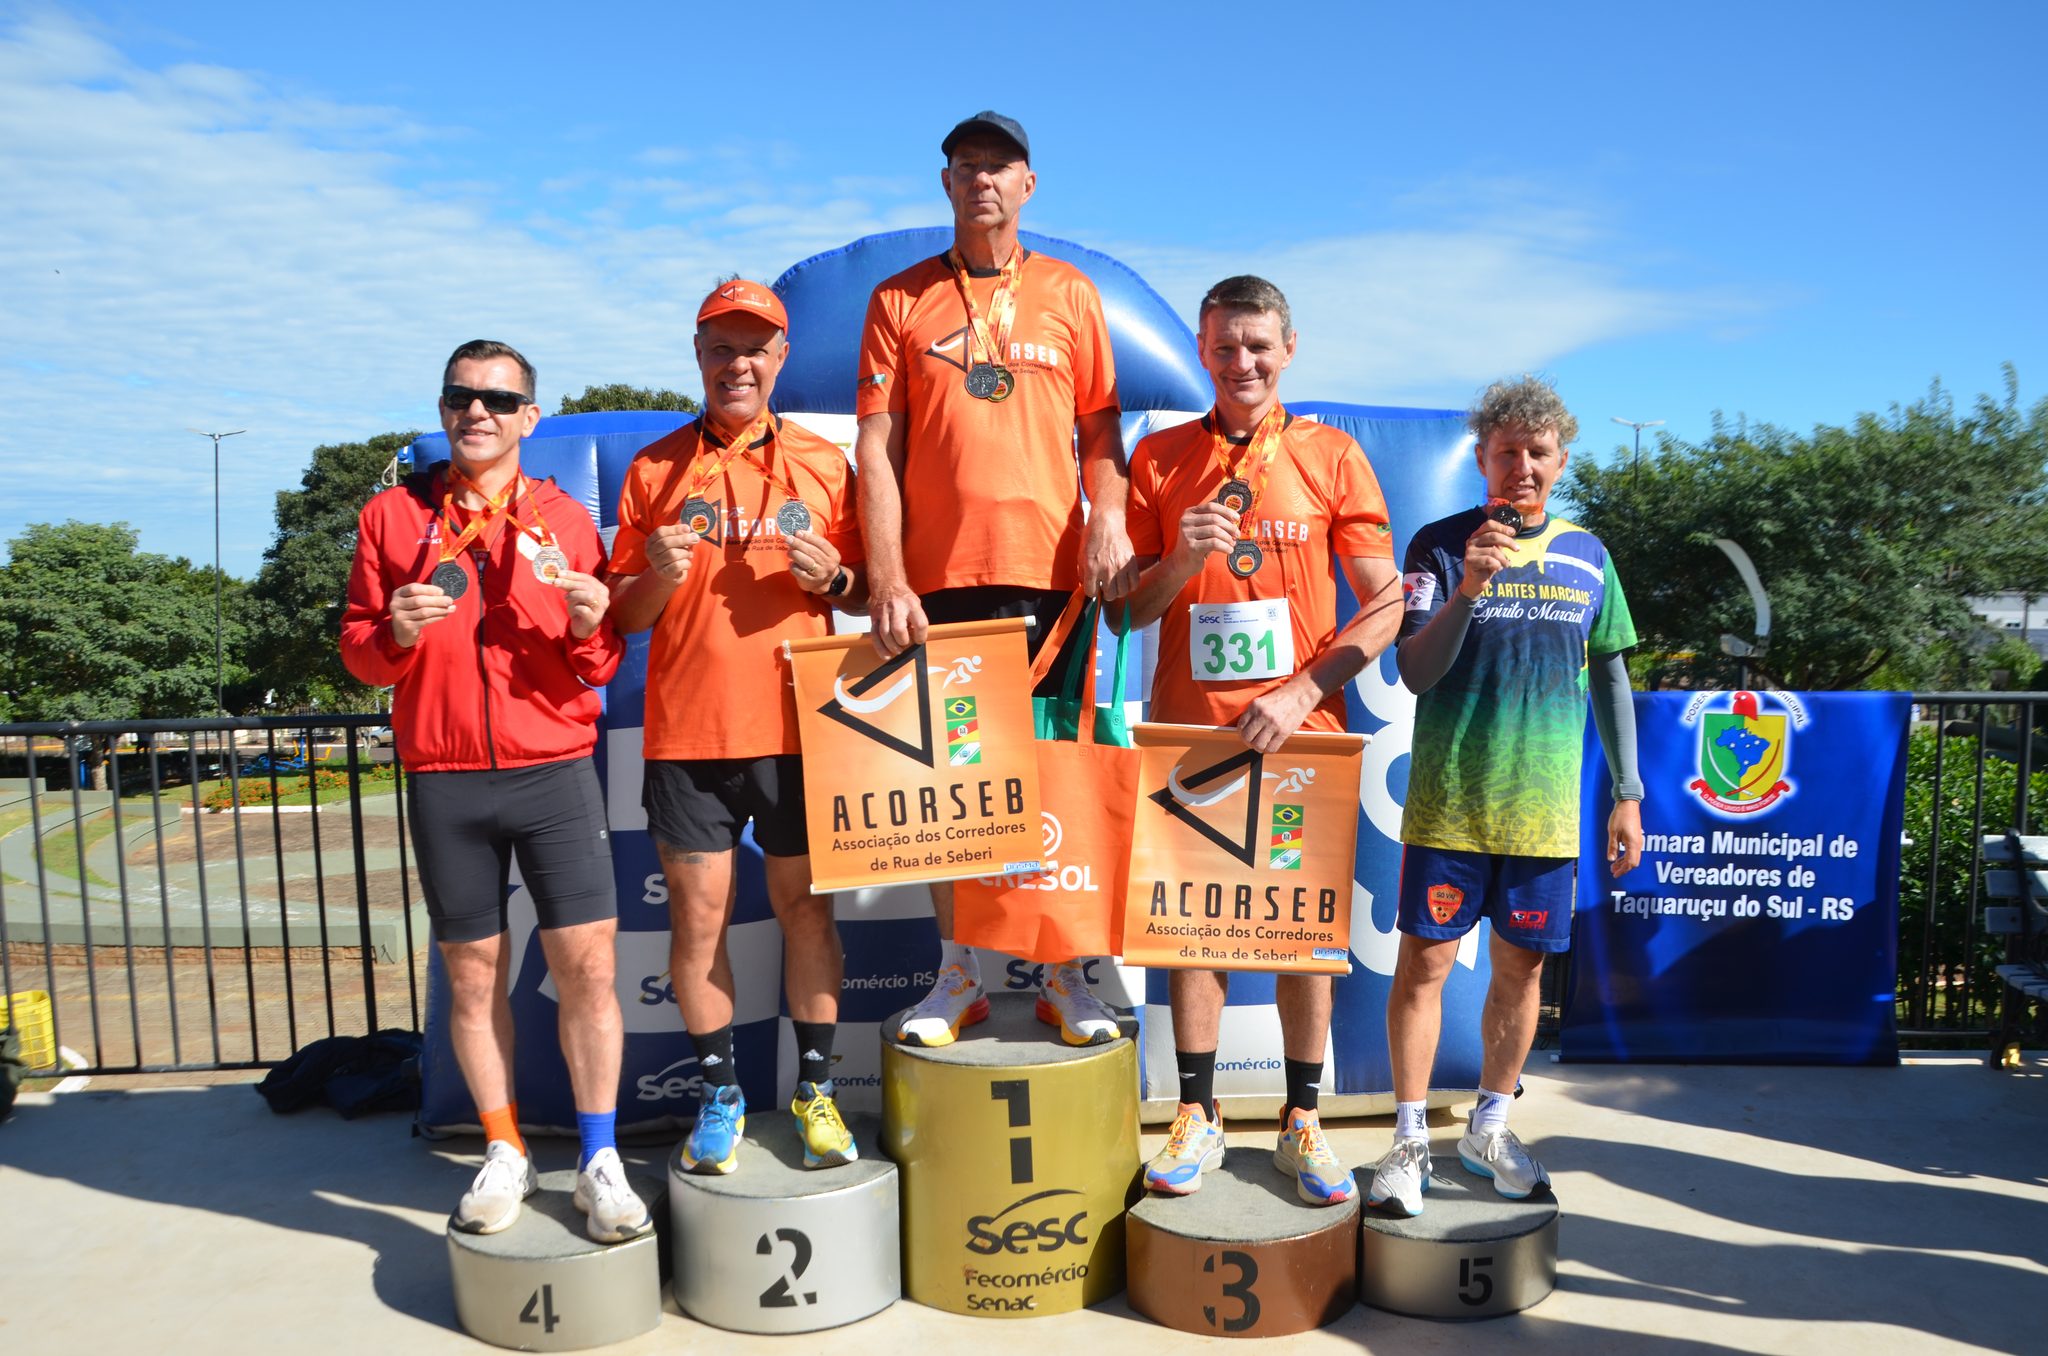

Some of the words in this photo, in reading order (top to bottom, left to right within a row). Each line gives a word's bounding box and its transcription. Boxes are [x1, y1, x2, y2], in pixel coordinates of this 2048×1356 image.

[1497, 582, 1536, 599] ARTES
[1538, 585, 1591, 606] MARCIAIS
[1469, 599, 1524, 624] Espírito
[1527, 602, 1586, 624] Marcial
[1203, 630, 1276, 674] 331
[1685, 693, 1708, 722] PODER
[1775, 690, 1804, 727] UNICIPAL
[833, 778, 1024, 833] ACORSEB
[832, 832, 910, 851] Associação
[915, 829, 941, 844] dos
[945, 822, 1026, 841] Corredores
[1619, 829, 1705, 853] mara
[1712, 831, 1823, 860] Municipal
[1829, 835, 1858, 858] de
[870, 857, 888, 871] de
[893, 855, 920, 869] Rua
[924, 852, 942, 866] de
[947, 847, 992, 863] Seberi
[1655, 861, 1781, 887] Vereadores
[1787, 865, 1815, 888] de
[1150, 880, 1336, 924] ACORSEB
[1611, 891, 1726, 921] Taquaruçu
[1732, 895, 1760, 917] do
[1766, 896, 1802, 919] Sul
[1821, 897, 1854, 920] RS
[1146, 922, 1221, 940] Associação
[1226, 924, 1250, 938] dos
[1255, 926, 1333, 942] Corredores
[1179, 946, 1196, 958] de
[1202, 947, 1227, 959] Rua
[1232, 948, 1249, 960] de
[1254, 949, 1297, 962] Seberi
[841, 975, 908, 989] omércio
[913, 971, 935, 987] RS
[1004, 959, 1100, 989] Sec
[1215, 1057, 1282, 1071] omércio
[636, 1074, 703, 1101] Ses
[832, 1074, 881, 1087] comér
[991, 1079, 1033, 1184] 1
[965, 1210, 1088, 1255] Sesc
[756, 1227, 817, 1308] 2
[965, 1262, 1088, 1288] Fecomércio
[1458, 1256, 1494, 1307] 5
[967, 1294, 1036, 1311] Senac
[1203, 1250, 1261, 1332] 3
[519, 1284, 560, 1333] 4
